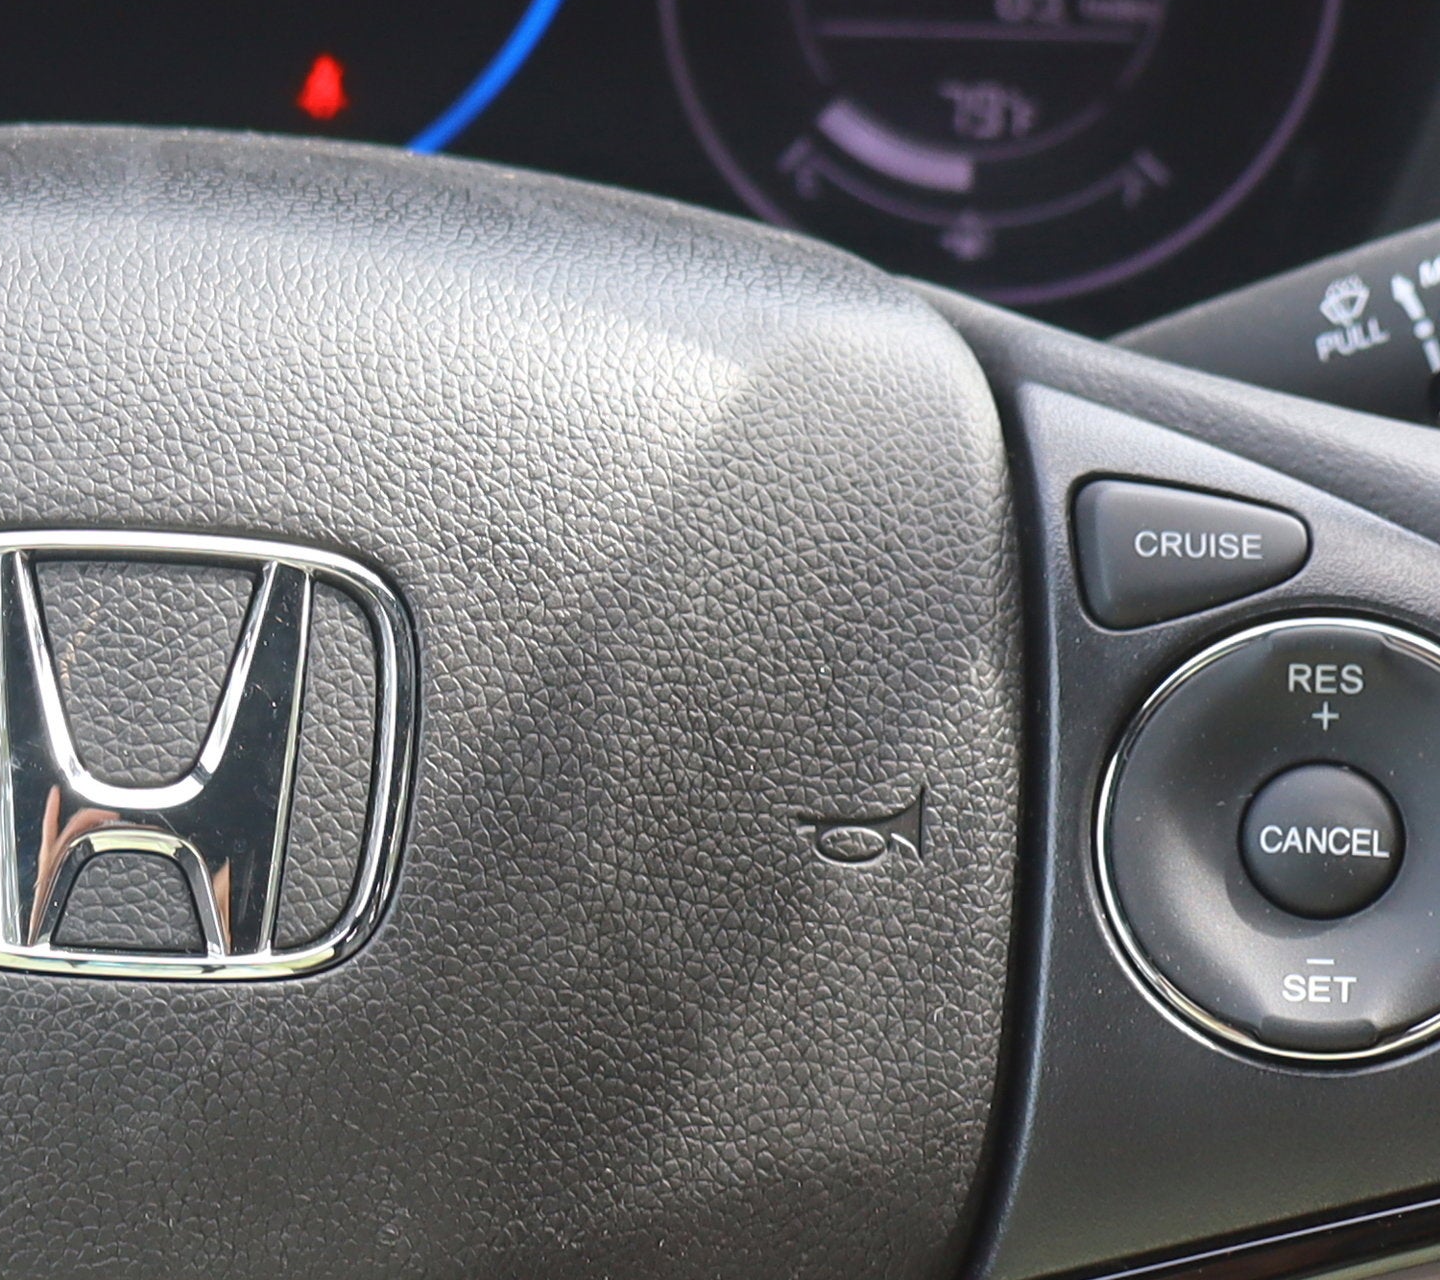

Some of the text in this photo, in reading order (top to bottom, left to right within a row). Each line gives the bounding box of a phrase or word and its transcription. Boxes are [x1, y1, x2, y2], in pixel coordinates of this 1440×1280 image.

[1314, 315, 1392, 363] PULL
[1133, 529, 1264, 561] CRUISE
[1287, 662, 1365, 696] RES
[1258, 823, 1391, 859] CANCEL
[1281, 972, 1358, 1004] SET
